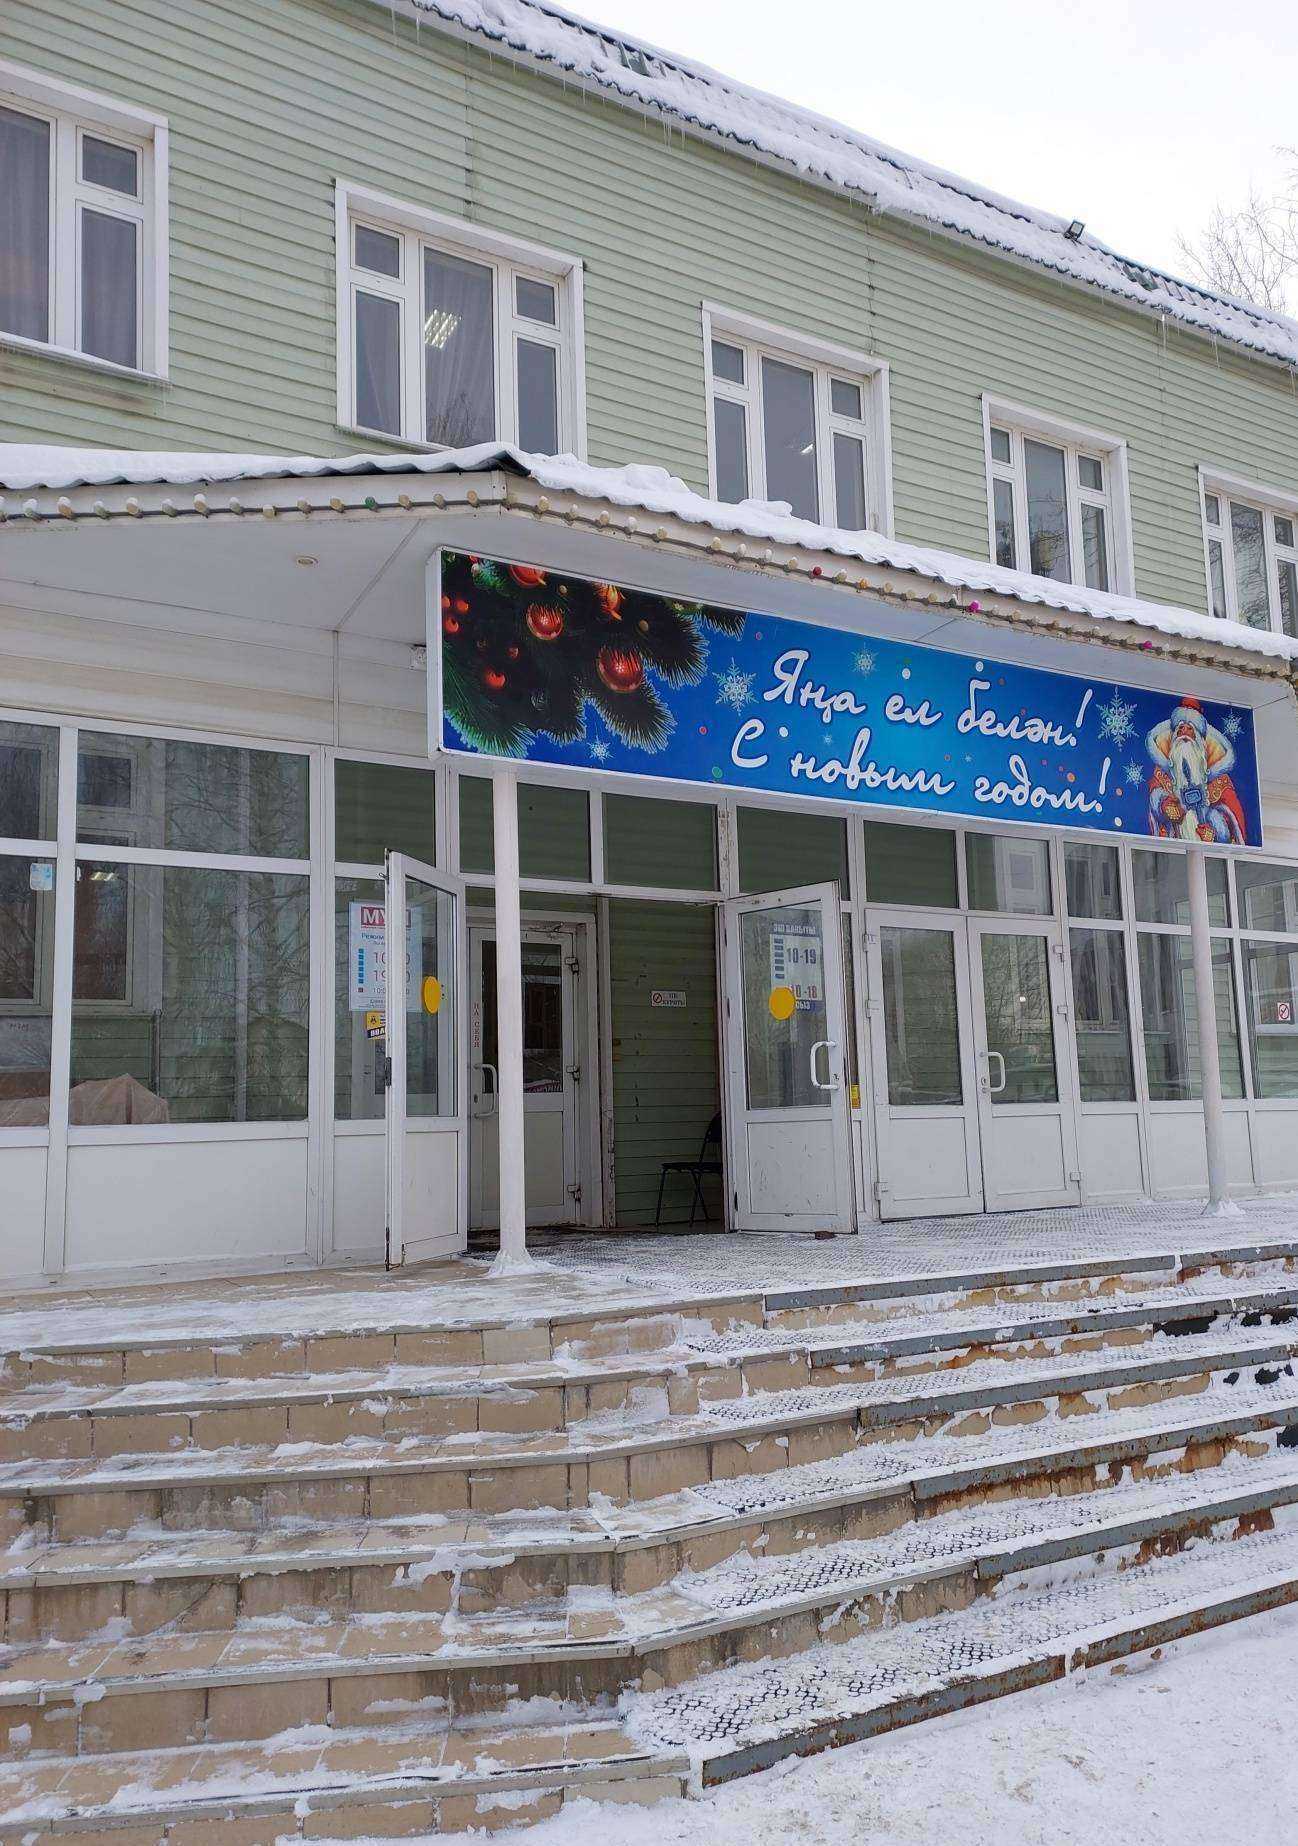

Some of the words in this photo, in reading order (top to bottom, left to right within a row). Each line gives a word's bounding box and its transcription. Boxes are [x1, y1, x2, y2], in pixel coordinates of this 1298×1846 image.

[763, 648, 866, 724] Яңа
[884, 692, 944, 727] ел
[956, 678, 1093, 748] белән!
[731, 717, 768, 769] С
[790, 727, 956, 796] новым
[974, 754, 1111, 814] годом!
